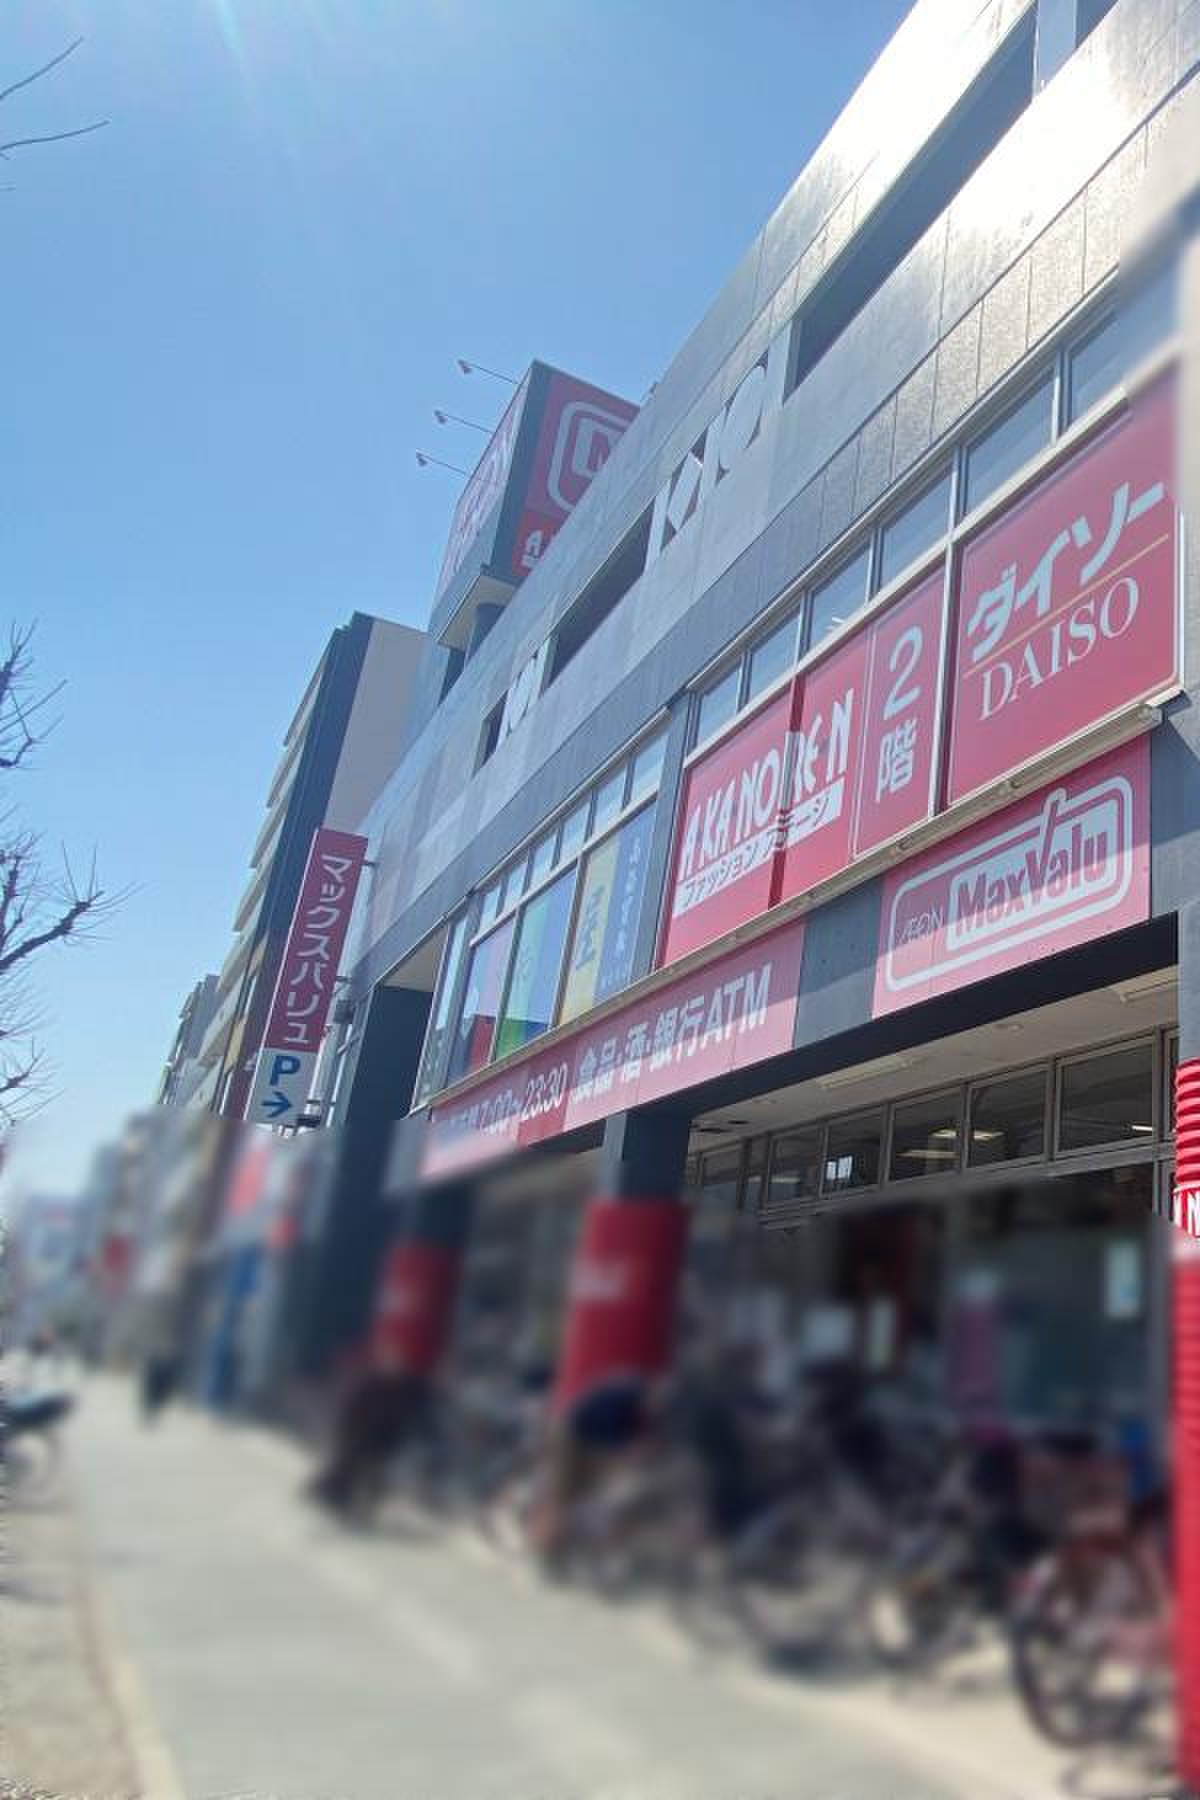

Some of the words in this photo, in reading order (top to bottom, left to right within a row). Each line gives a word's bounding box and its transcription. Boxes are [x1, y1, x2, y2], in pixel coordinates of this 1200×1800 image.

[966, 482, 1164, 664] ダイソー
[978, 577, 1139, 722] DAISO
[955, 800, 1108, 936] MaxValu
[269, 1055, 300, 1086] P
